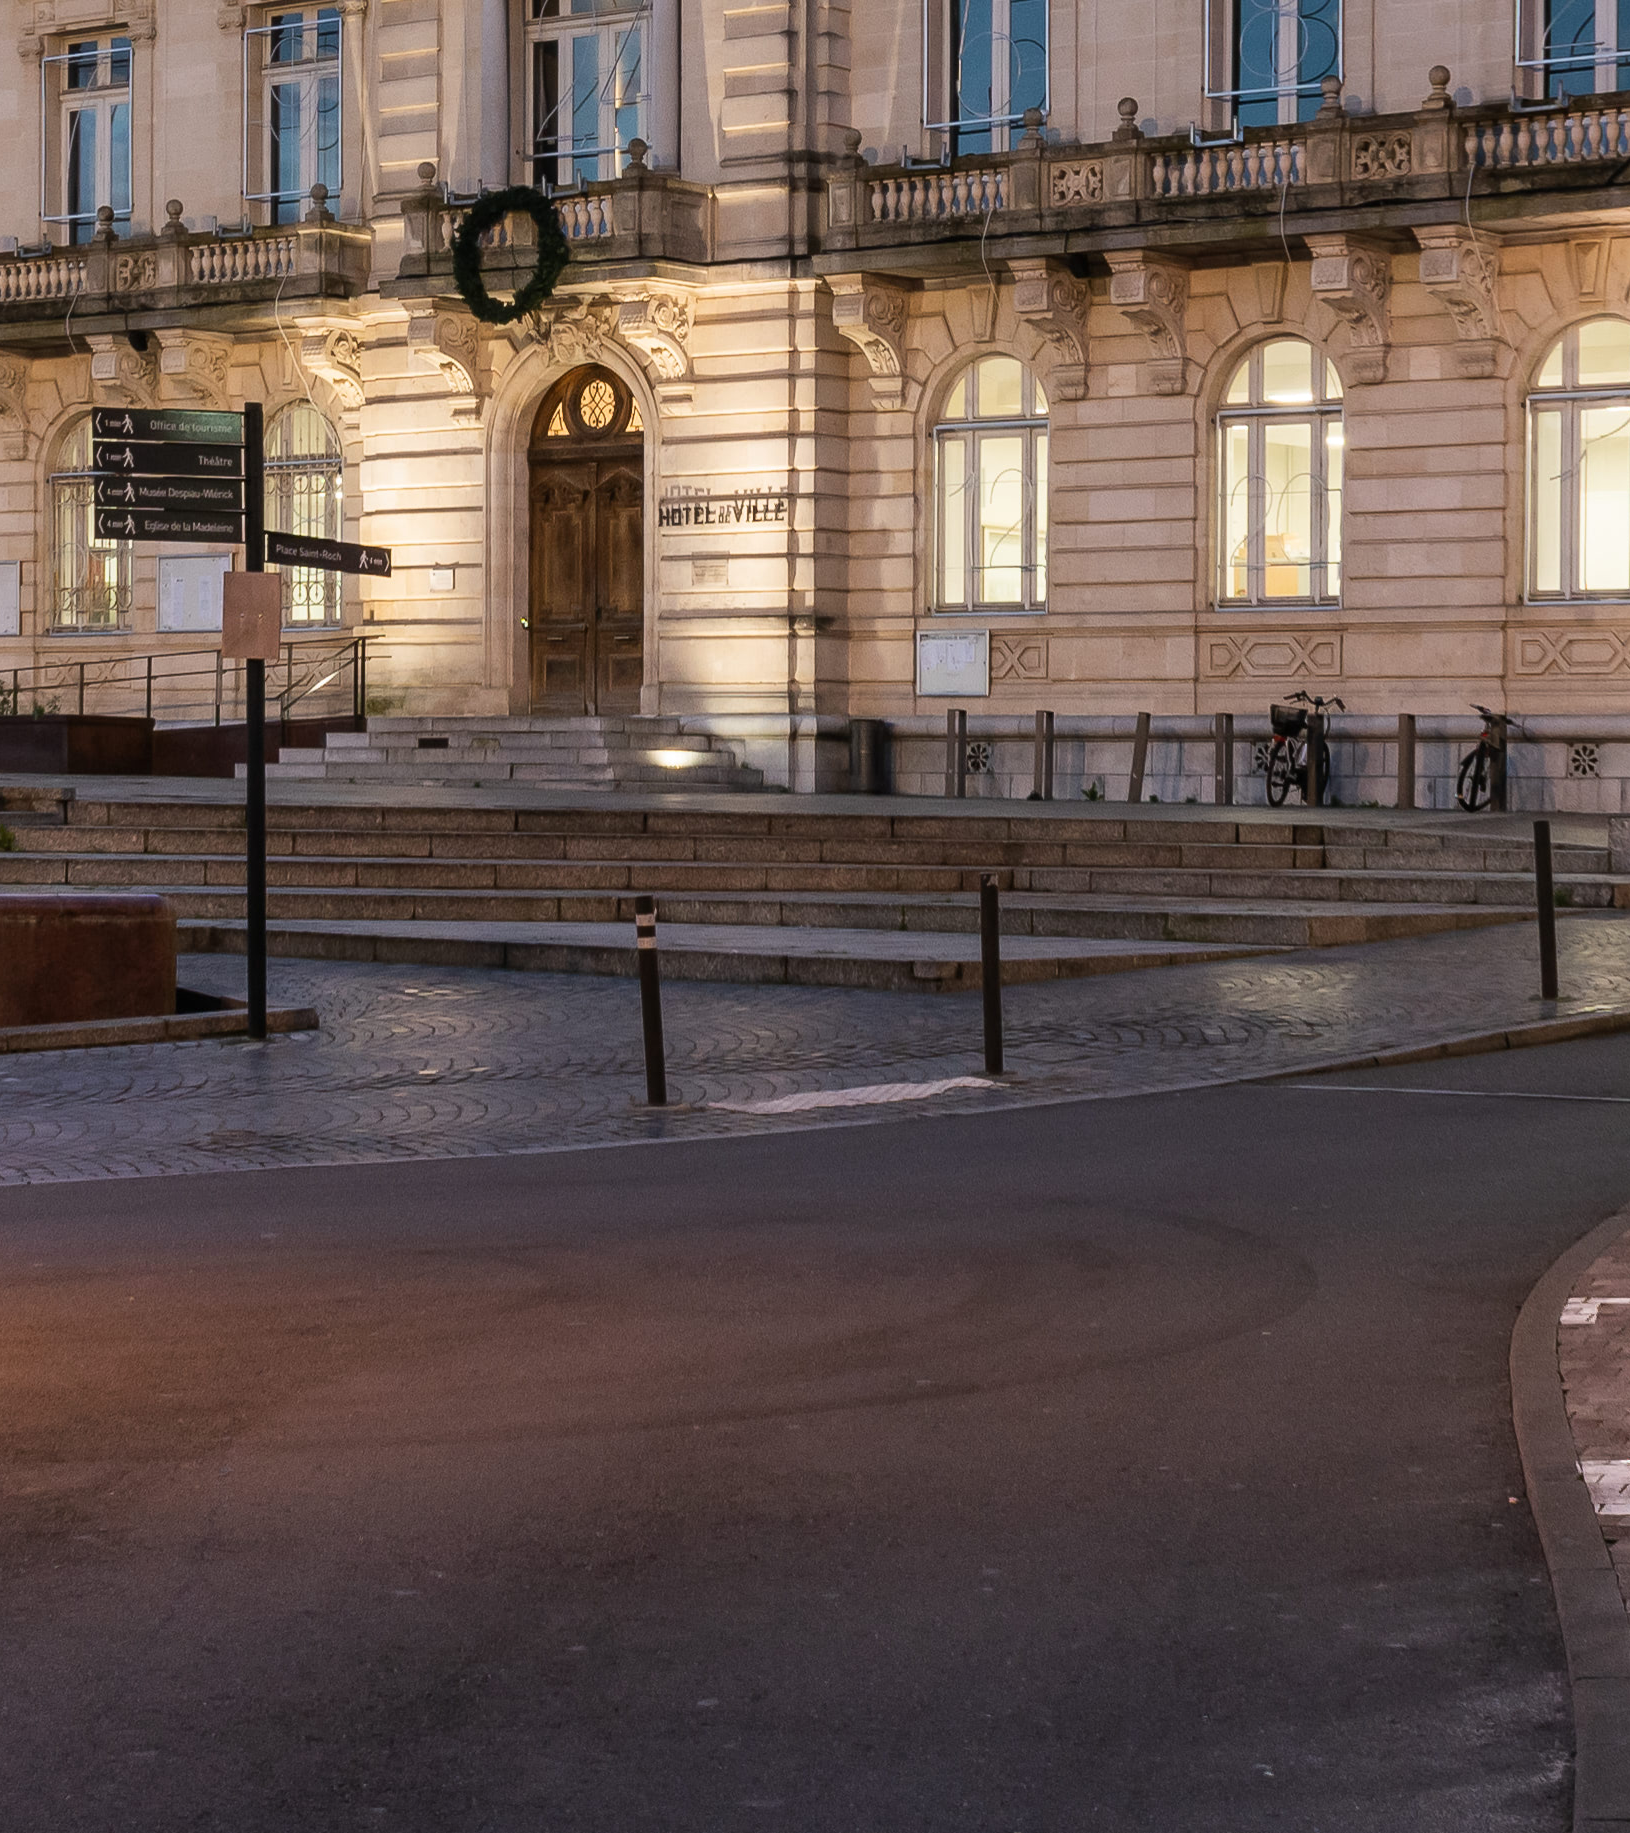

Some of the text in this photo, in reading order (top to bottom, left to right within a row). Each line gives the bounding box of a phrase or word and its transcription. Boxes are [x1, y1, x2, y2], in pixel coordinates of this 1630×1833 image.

[150, 419, 177, 431] Office
[178, 421, 191, 432] de
[192, 423, 233, 434] tourisme
[198, 454, 233, 467] Théâtre
[139, 485, 167, 498] Musée
[733, 504, 785, 523] VILLE
[171, 520, 182, 531] de
[192, 522, 234, 533] Madeleine
[276, 543, 342, 562] Place Saint-Roch
